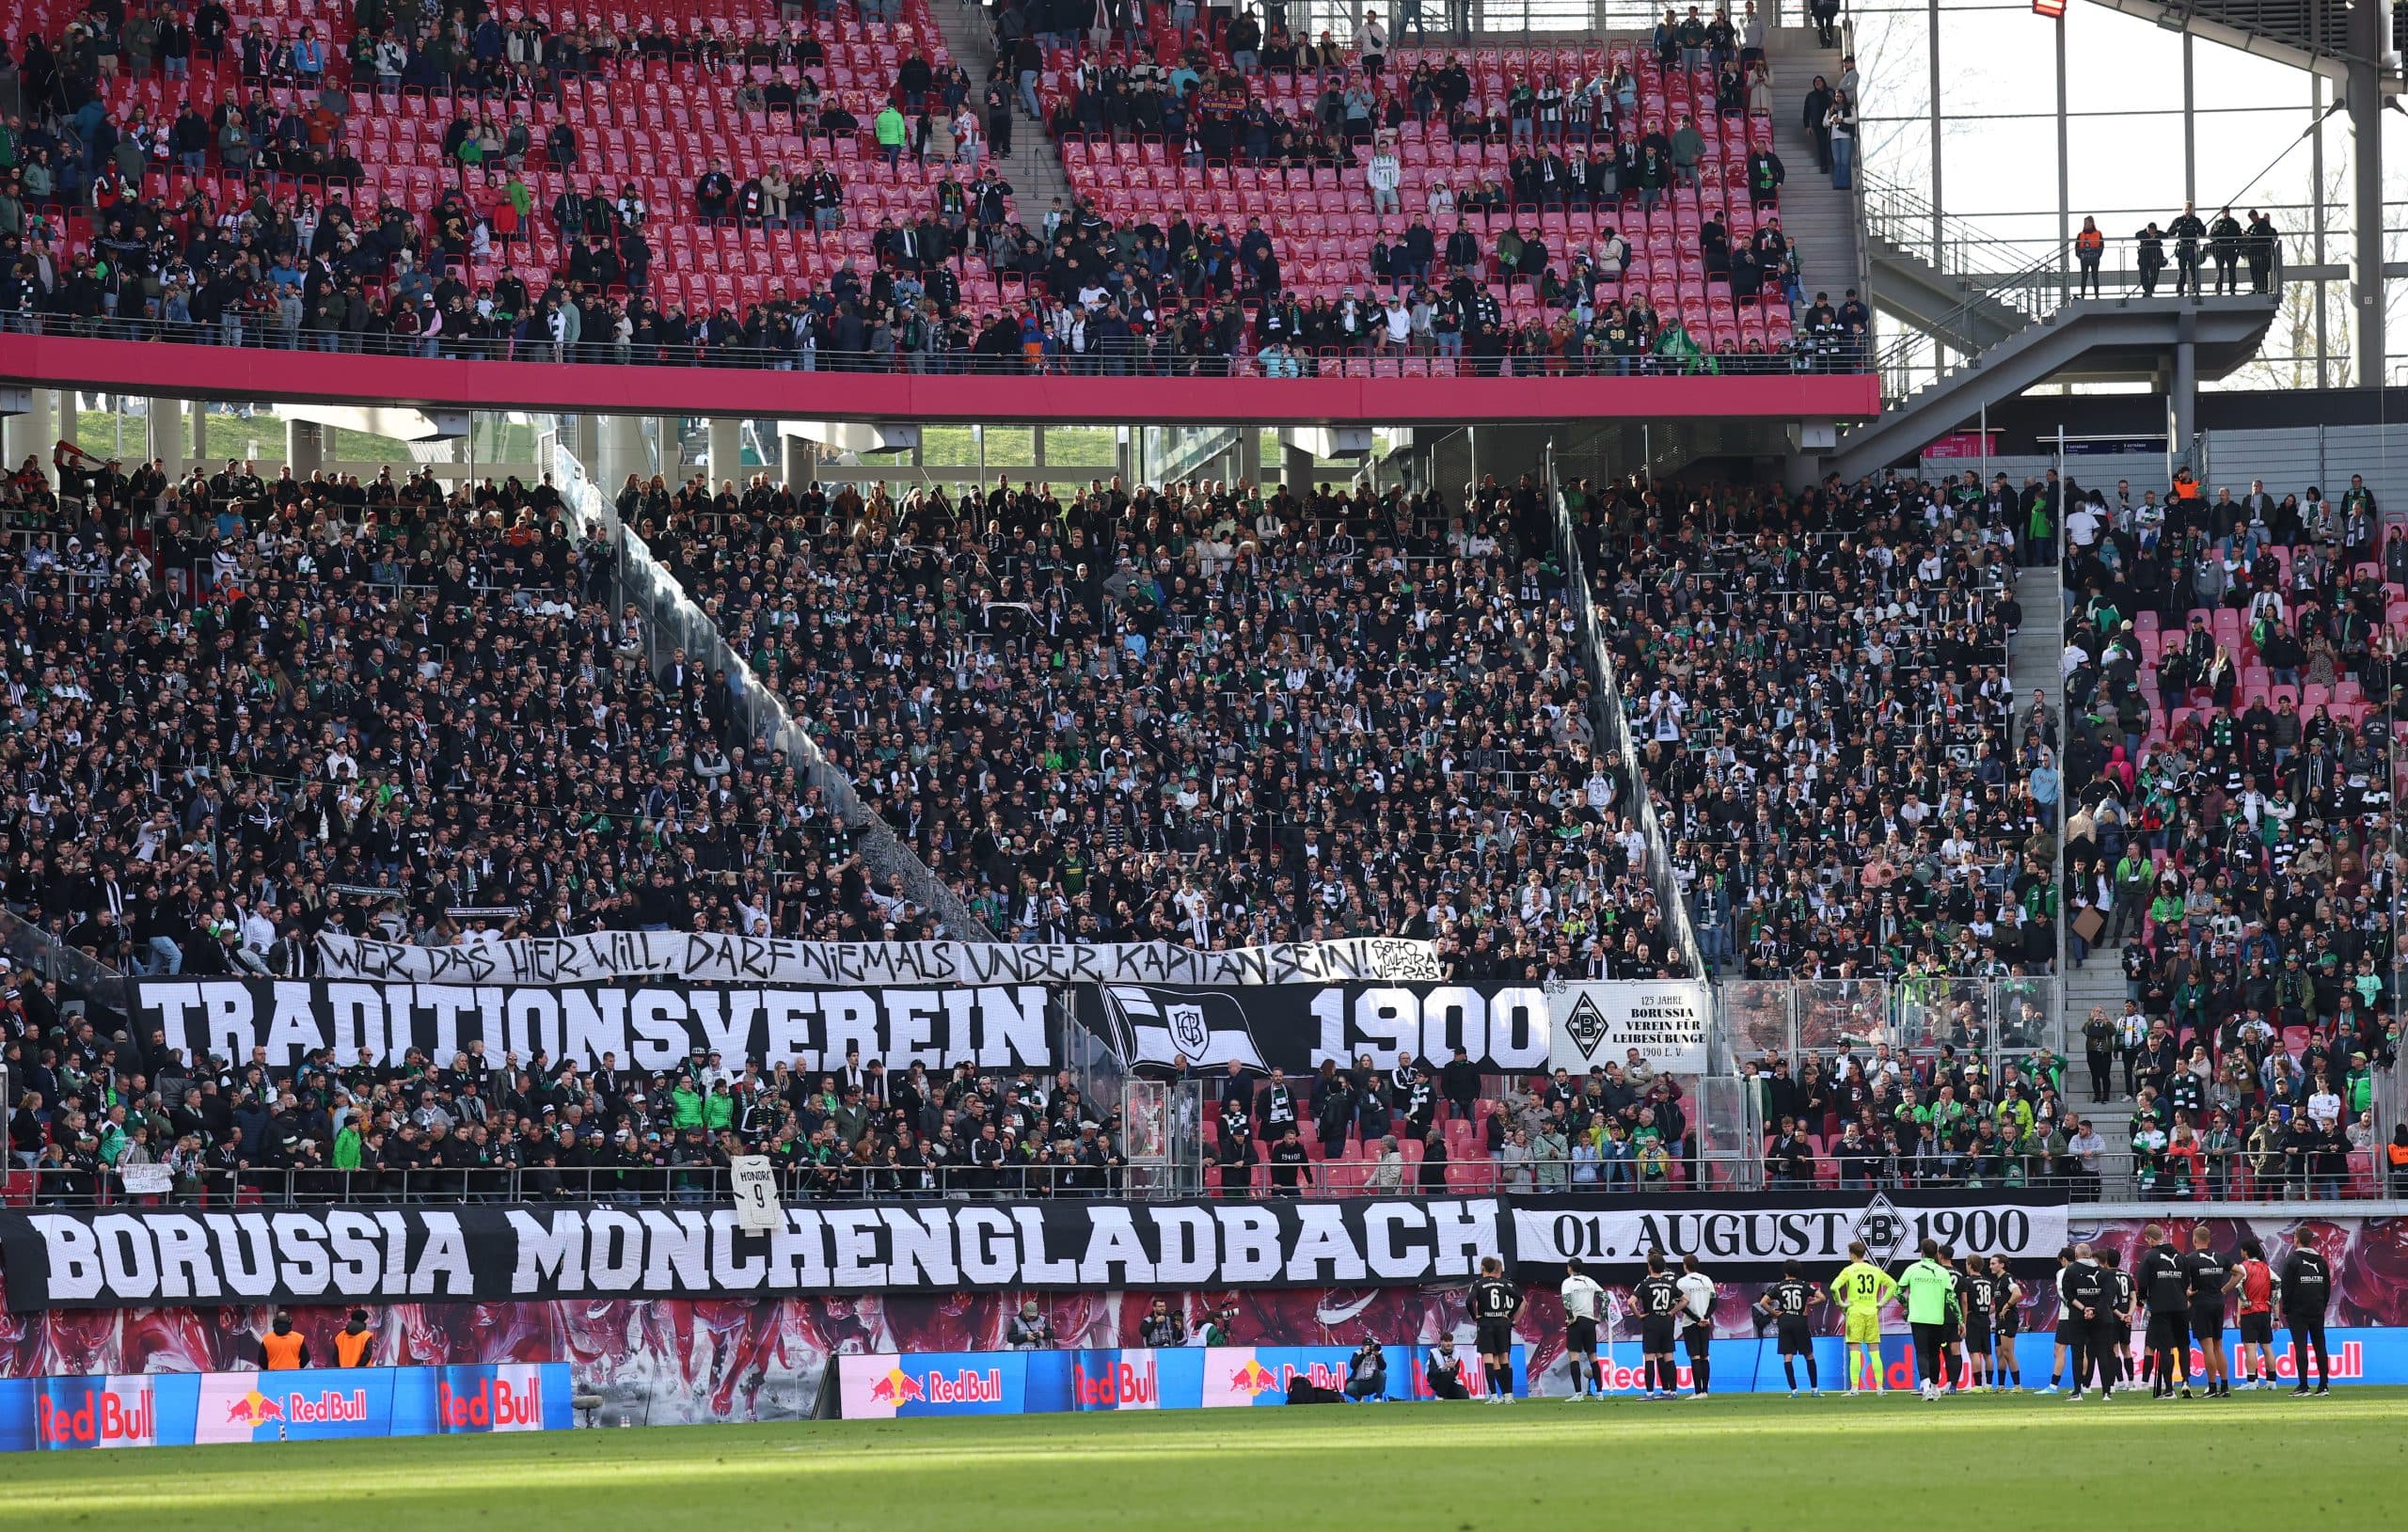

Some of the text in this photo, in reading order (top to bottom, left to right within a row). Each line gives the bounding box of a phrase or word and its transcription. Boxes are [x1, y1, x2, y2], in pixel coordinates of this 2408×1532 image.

[318, 937, 414, 981] WER
[425, 943, 496, 983] DAS
[685, 934, 798, 979] DARF
[964, 943, 1106, 984] UNSER
[1116, 941, 1267, 985] KAPITÄN
[1372, 965, 1439, 979] ULTRAS
[1657, 996, 1684, 1005] JAHRE
[1625, 1019, 1701, 1031] VEREIN FÜR
[1631, 1008, 1694, 1018] BORUSSIA
[139, 982, 1053, 1072] TRADITIONSVEREIN
[1310, 985, 1550, 1073] 1900
[1578, 1013, 1598, 1038] B
[1642, 1047, 1685, 1057] 1900 E. V.
[753, 1184, 765, 1208] 9
[1553, 1207, 2030, 1257] 01. AUGUST B 1900
[27, 1197, 1505, 1300] BORUSSIA MÖNCHENGLADBACH
[1857, 1273, 1875, 1294] 33
[1976, 1285, 1991, 1305] 38
[1490, 1288, 1500, 1310] 6
[1652, 1288, 1671, 1311] 29
[1782, 1288, 1802, 1310] 36
[930, 1369, 1001, 1401] Red Bull
[1074, 1361, 1156, 1404] Red Bull
[292, 1391, 366, 1420] Red Bull
[439, 1378, 540, 1427] Red Bull
[39, 1389, 151, 1443] Red Bull
